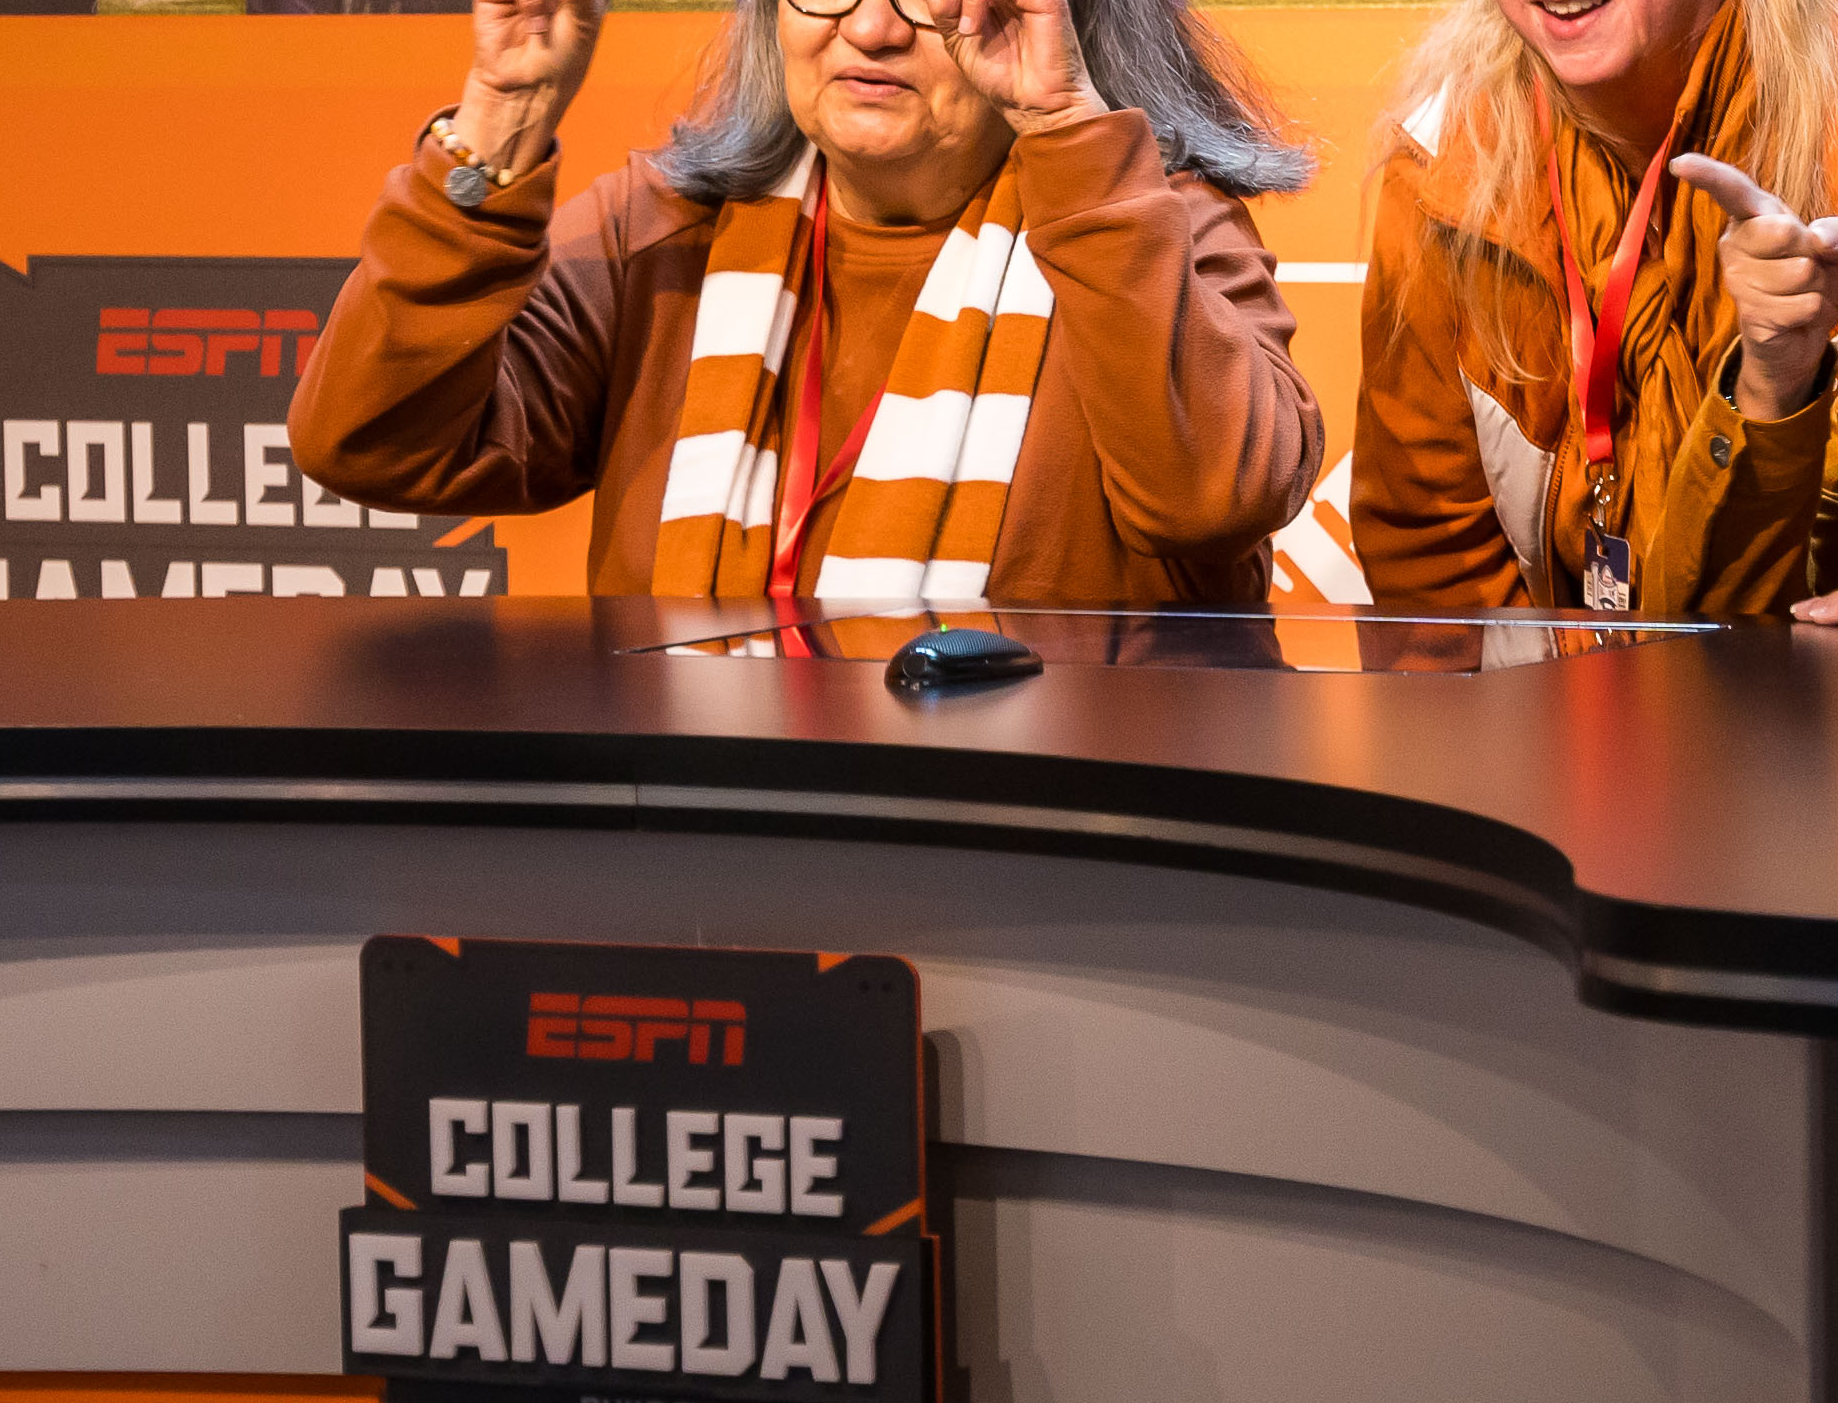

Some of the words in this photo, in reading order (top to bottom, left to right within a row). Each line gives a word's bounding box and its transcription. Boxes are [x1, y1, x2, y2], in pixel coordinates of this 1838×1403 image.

[3, 419, 420, 529] COLLE
[526, 993, 747, 1066] ESPN
[428, 1097, 844, 1217] COLLEGE
[349, 1232, 901, 1385] GAMEDAY
